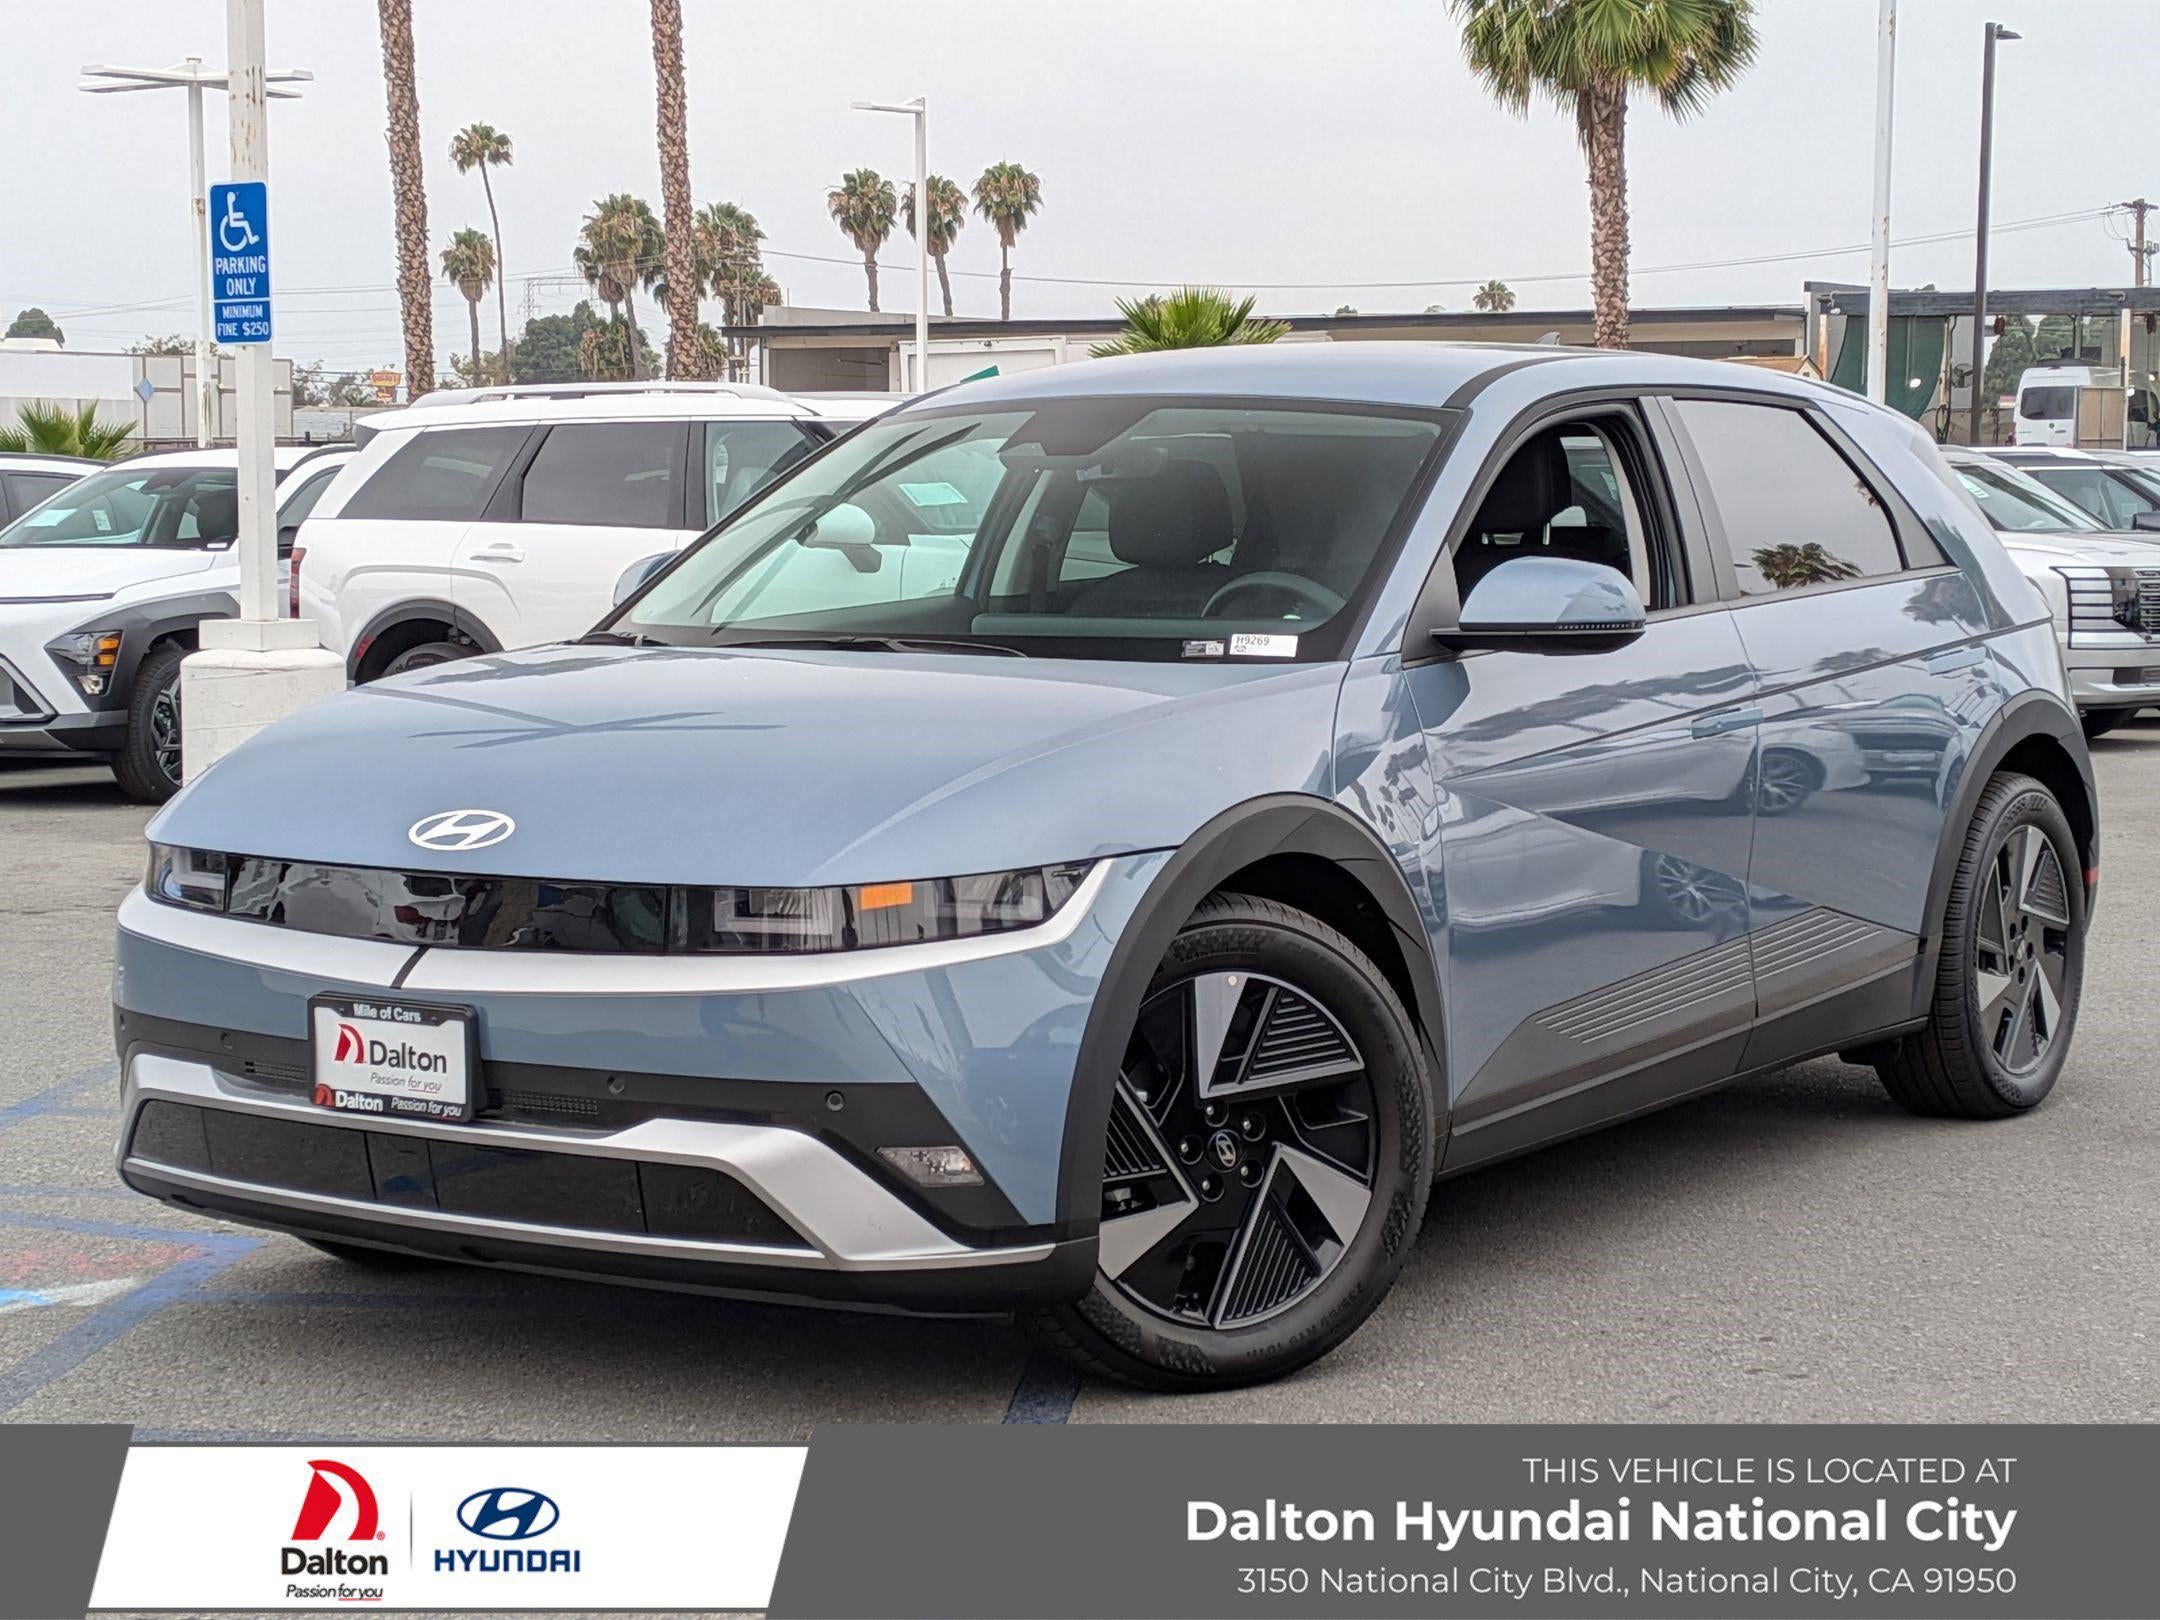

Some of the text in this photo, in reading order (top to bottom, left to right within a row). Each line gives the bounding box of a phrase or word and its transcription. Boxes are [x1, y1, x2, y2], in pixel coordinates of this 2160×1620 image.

[215, 255, 266, 275] PARKING
[226, 277, 256, 296] ONLY
[222, 304, 263, 319] MINIMUM
[217, 321, 269, 336] FINE $250
[353, 1003, 422, 1022] Mile of Cars
[370, 1040, 447, 1073] Dalton
[370, 1072, 443, 1092] Passion for you
[335, 1091, 462, 1118] Dalton Passion for you
